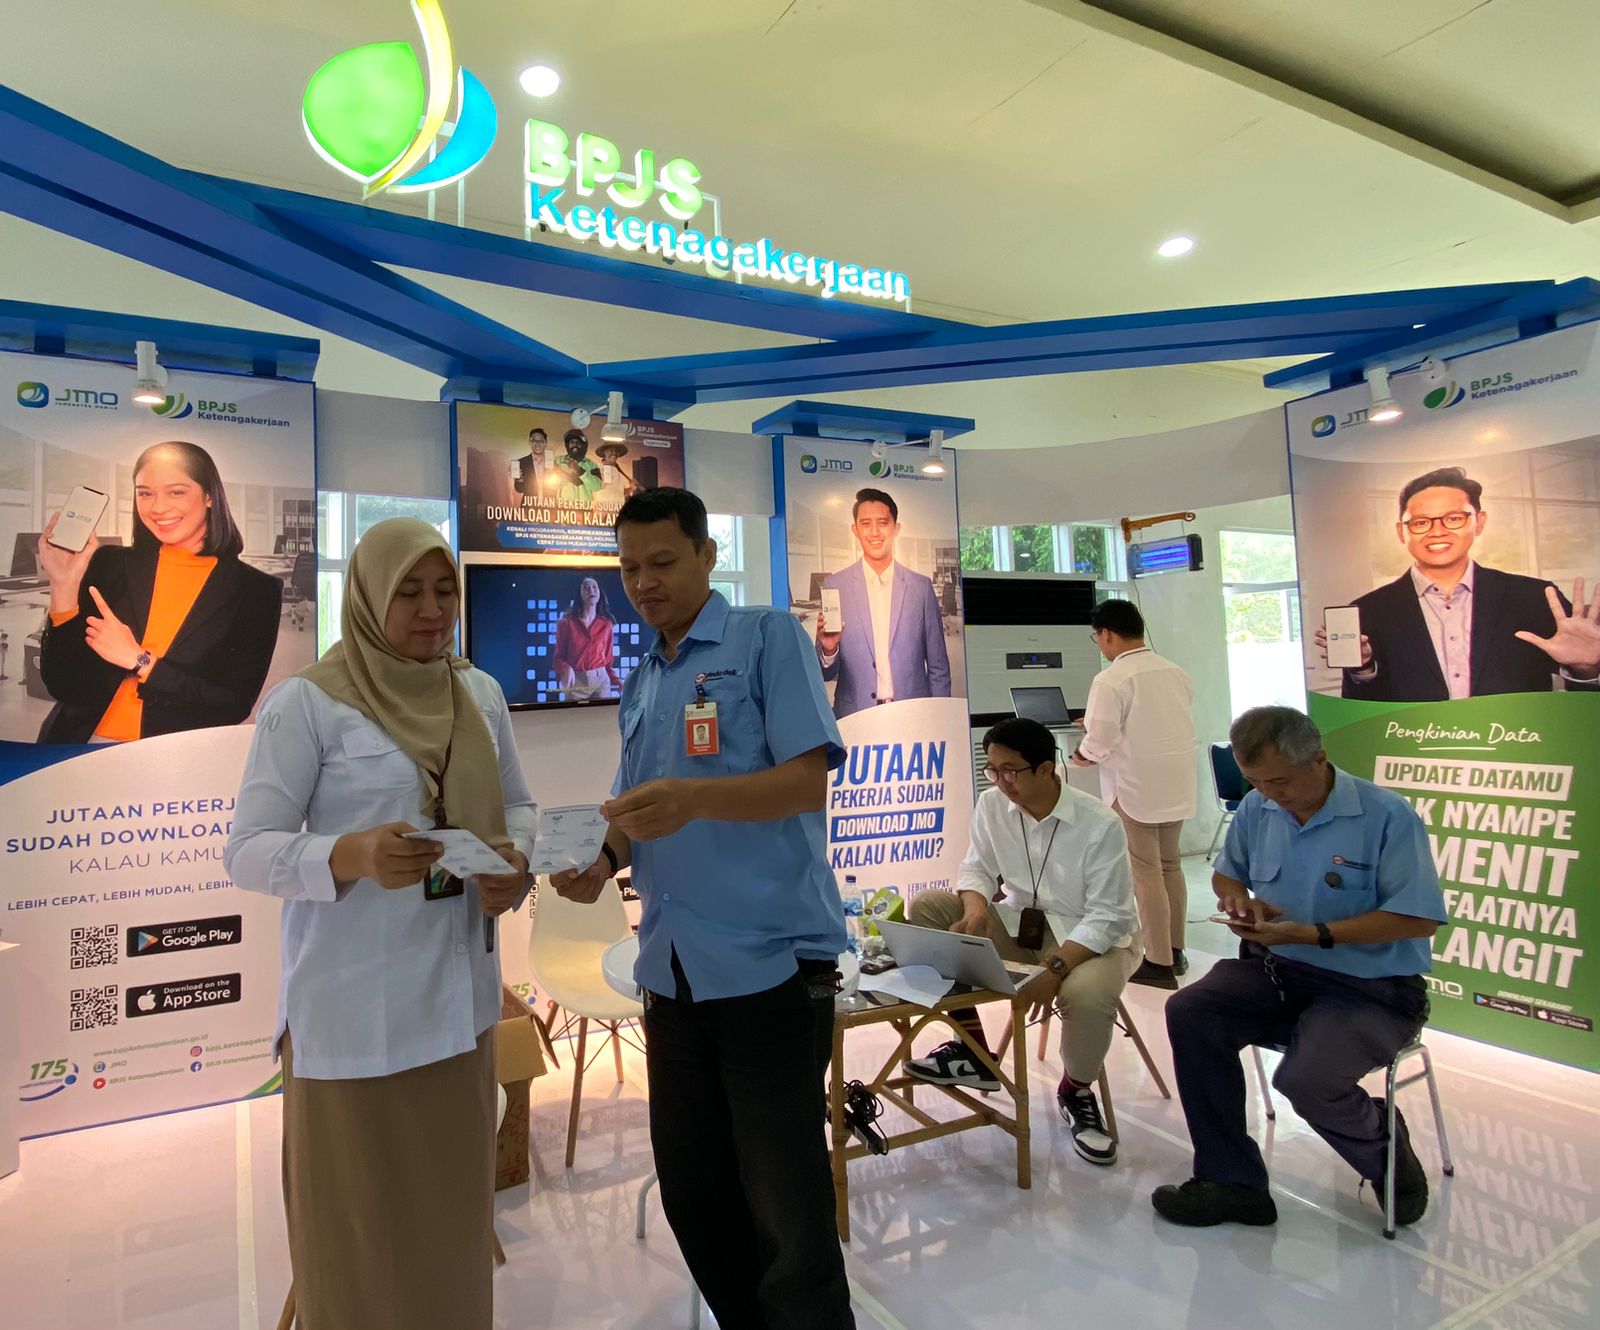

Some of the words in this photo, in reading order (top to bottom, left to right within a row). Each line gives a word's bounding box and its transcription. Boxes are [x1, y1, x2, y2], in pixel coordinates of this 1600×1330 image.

[525, 118, 703, 219] BPJS
[526, 182, 911, 302] Ketenagakerjaan
[1470, 372, 1513, 391] BPJS
[1471, 369, 1578, 400] Ketenagakerjaan
[55, 388, 118, 405] JMO
[198, 399, 237, 413] BPJS
[198, 412, 290, 427] Ketenagakerjaan
[820, 458, 853, 470] JMO
[893, 463, 915, 473] BPJS
[522, 495, 555, 508] JUTAAN
[558, 498, 594, 511] PEKERJA
[487, 506, 550, 523] DOWNLOAD
[554, 511, 580, 524] JMO.
[1385, 721, 1480, 743] Pengkinian
[1488, 722, 1542, 744] Data
[832, 741, 946, 788] JUTAAN
[1384, 762, 1464, 786] UPDATE
[1468, 767, 1564, 793] DATAMU
[831, 786, 892, 810] PEKERJA
[897, 783, 944, 804] SUDAH
[46, 804, 142, 824] JUTAAN
[152, 798, 235, 816] PEKERJ
[1442, 800, 1576, 840] NYAMPE
[836, 813, 907, 838] DOWNLOAD
[910, 811, 936, 831] JMO
[6, 833, 90, 853] SUDAH
[832, 841, 886, 870] KALAU
[890, 837, 944, 863] KAMU?
[70, 853, 150, 874] KALAU
[161, 846, 226, 866] KAMU
[1428, 834, 1580, 897] MENIT
[8, 899, 47, 911] LEBIH
[52, 894, 99, 906] CEPAT,
[103, 889, 141, 901] LEBIH
[145, 884, 194, 897] MUDAH,
[198, 879, 233, 891] LEBIH
[624, 887, 640, 897] Pla
[908, 882, 927, 893] LEBIH
[1443, 889, 1577, 939] FAATNYA
[162, 927, 177, 935] GET
[162, 932, 207, 947] Google
[209, 929, 233, 942] Play
[1430, 926, 1583, 988] LANGIT
[163, 982, 203, 994] Download
[217, 979, 230, 987] the
[512, 982, 530, 997] 75
[1420, 975, 1463, 996] MO
[163, 994, 192, 1009] App
[195, 988, 231, 1002] Store
[30, 1058, 68, 1081] 175
